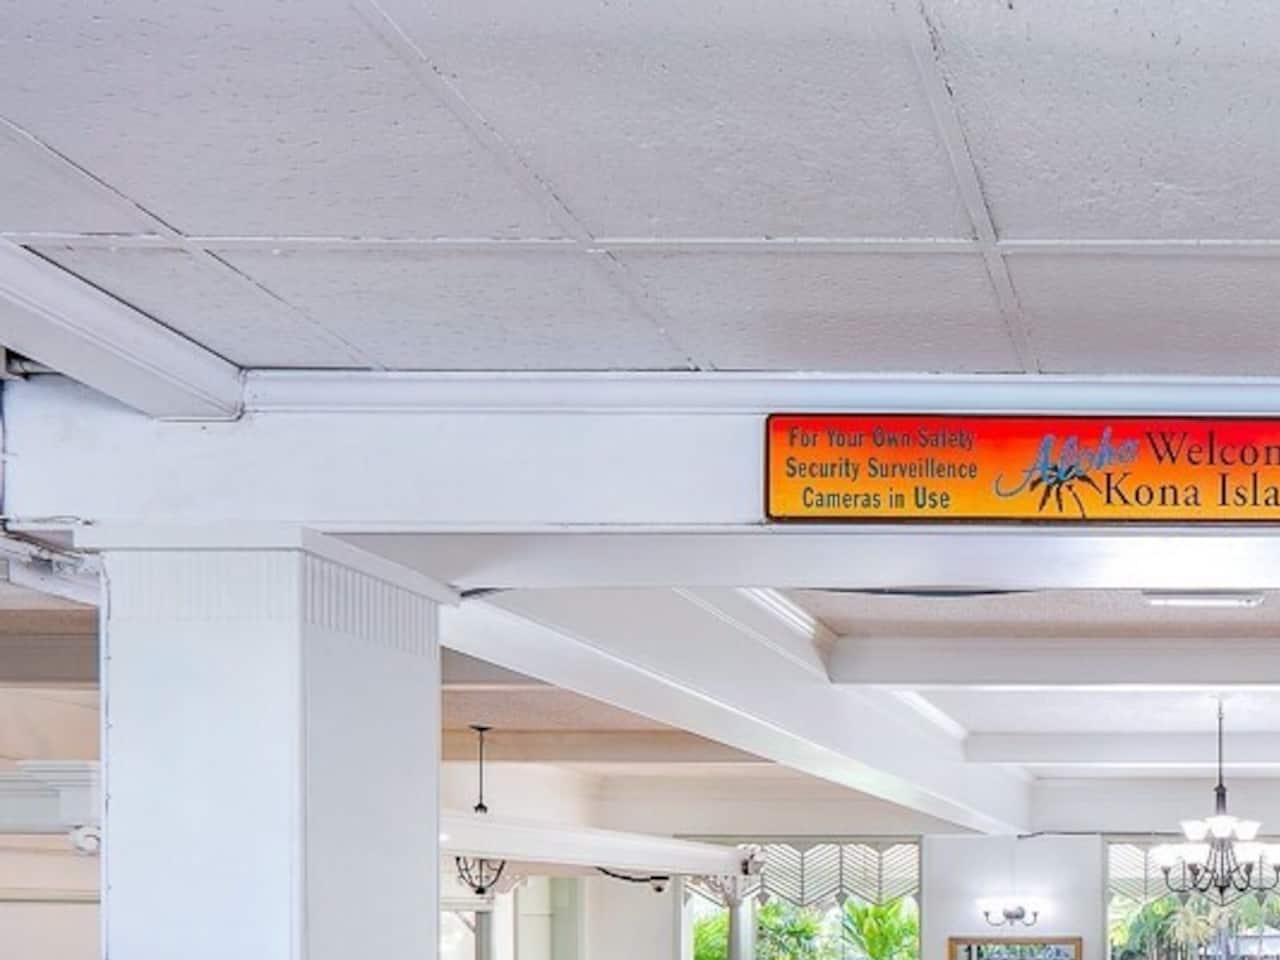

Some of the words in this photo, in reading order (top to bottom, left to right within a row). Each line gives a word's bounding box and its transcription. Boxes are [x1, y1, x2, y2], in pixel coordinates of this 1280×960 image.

[788, 426, 817, 447] For
[827, 426, 864, 447] Your
[872, 426, 911, 447] Own
[918, 426, 974, 450] Safety
[786, 457, 860, 482] Security
[868, 457, 977, 479] Surveillence
[802, 486, 881, 509] Cameras
[889, 487, 905, 509] in
[914, 486, 951, 509] Use
[1104, 472, 1202, 507] Kona
